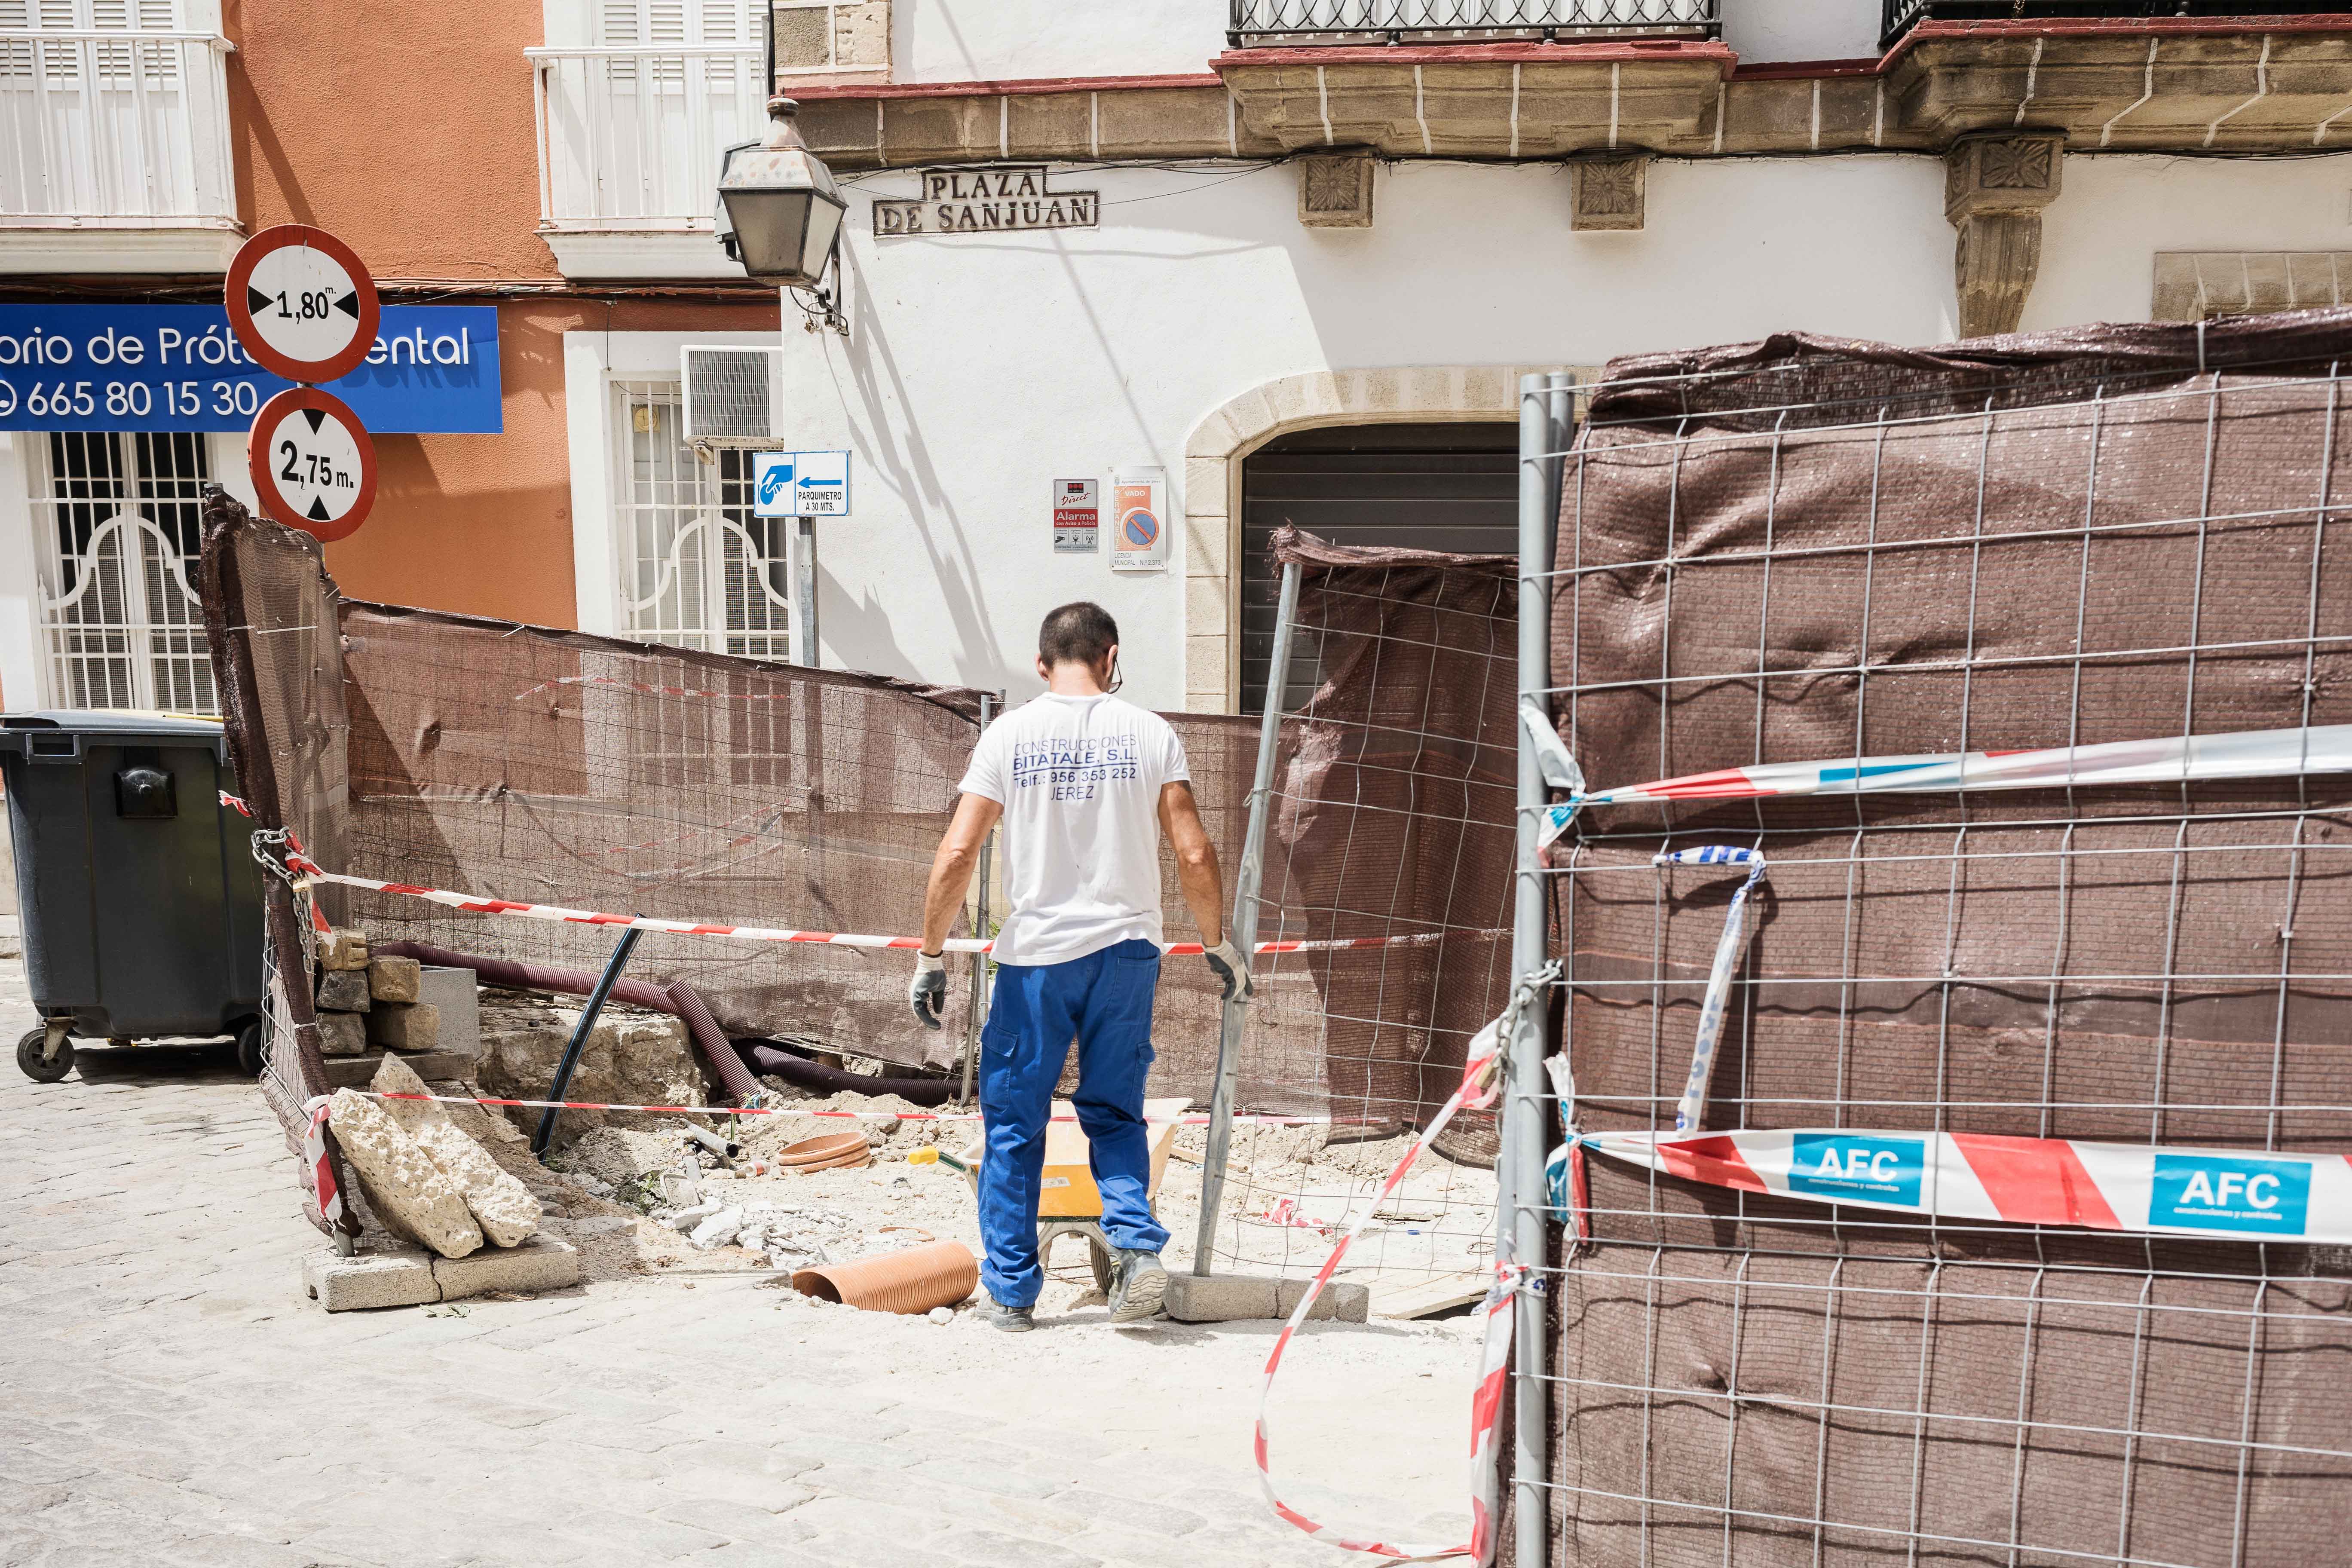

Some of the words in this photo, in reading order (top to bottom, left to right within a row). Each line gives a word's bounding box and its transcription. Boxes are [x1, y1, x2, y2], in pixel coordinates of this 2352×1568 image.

[931, 174, 1037, 199] PLAZA
[882, 206, 922, 231] DE
[277, 291, 329, 325] 1,80
[87, 327, 144, 364] de
[364, 327, 469, 364] ental
[28, 381, 95, 416] 665
[106, 381, 151, 416] 80
[163, 382, 201, 416] 15
[212, 381, 258, 416] 30
[280, 440, 332, 490] 2,75
[337, 471, 354, 489] m.
[798, 491, 842, 500] PARQUIMETRO
[805, 502, 810, 511] A
[812, 502, 818, 511] 30
[820, 502, 835, 511] MTS.
[1061, 492, 1092, 505] Direct
[1056, 511, 1096, 521] Alarma
[1015, 735, 1136, 756] CONSTRUCCIONES
[1107, 749, 1137, 761] S.L.
[1051, 772, 1075, 783] 956
[1082, 769, 1106, 781] 353
[1112, 768, 1136, 779] 252
[1051, 786, 1094, 800] JEREZ
[1814, 1147, 1899, 1182] AFC
[2179, 1170, 2281, 1210] AFC
